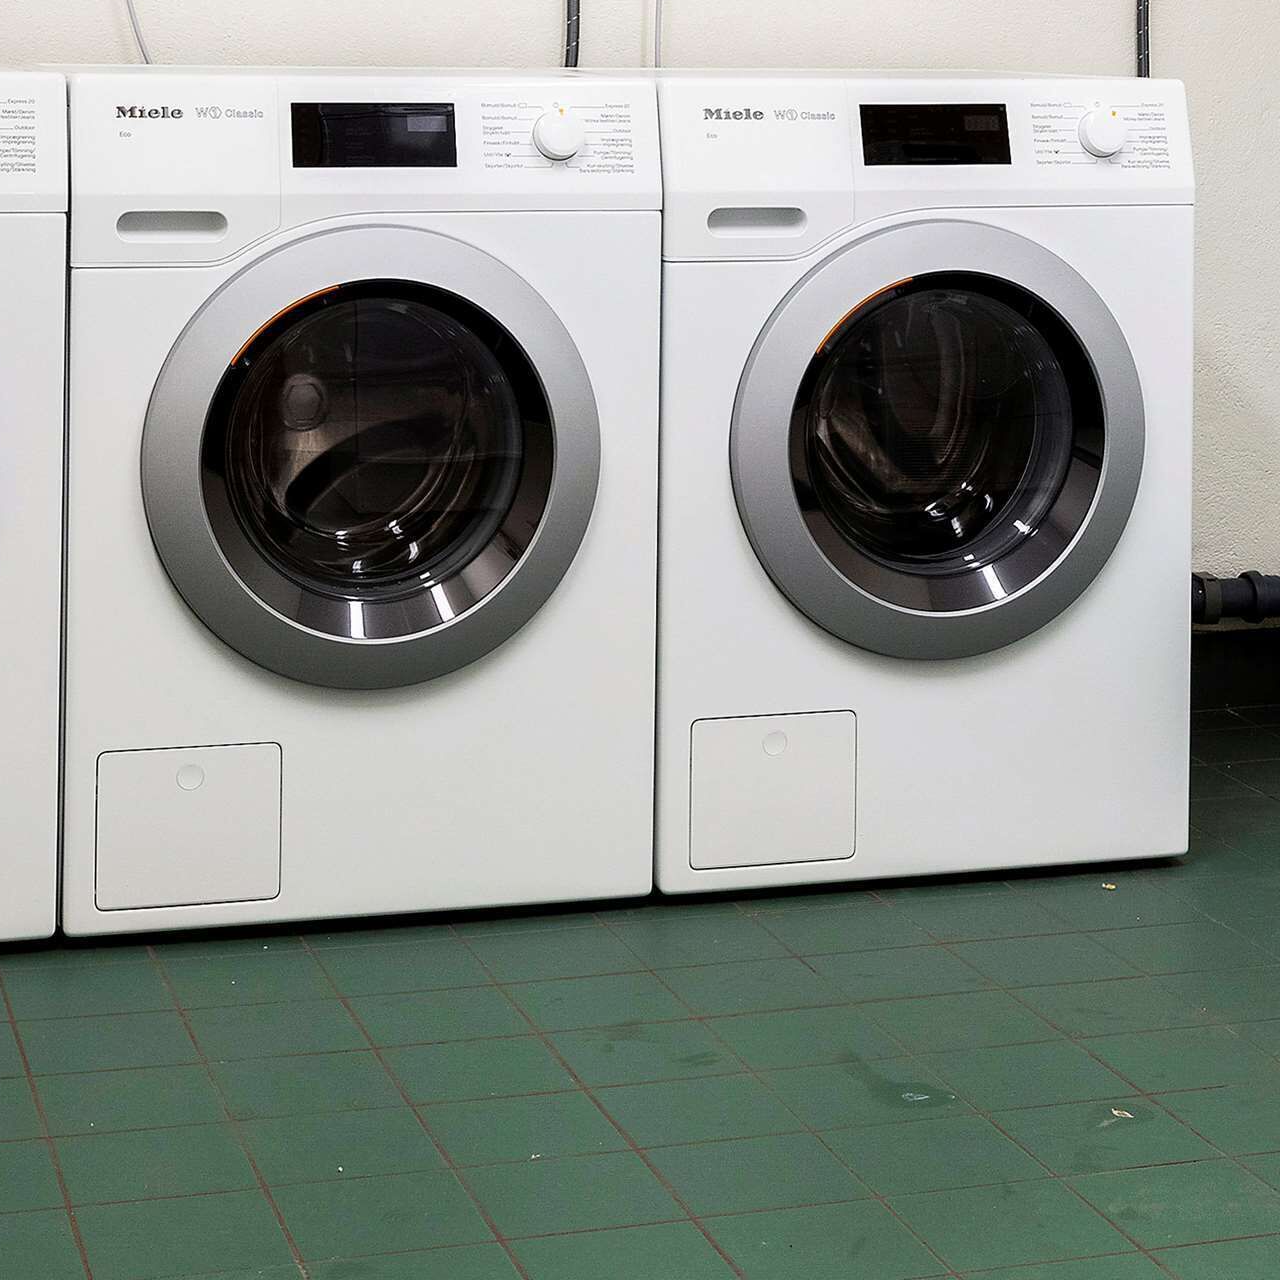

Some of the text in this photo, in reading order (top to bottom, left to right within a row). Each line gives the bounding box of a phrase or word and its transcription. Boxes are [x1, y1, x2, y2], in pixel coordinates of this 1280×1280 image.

[116, 106, 183, 119] Miele
[225, 108, 264, 119] Classic
[703, 107, 764, 120] Miele
[800, 111, 836, 120] Classic
